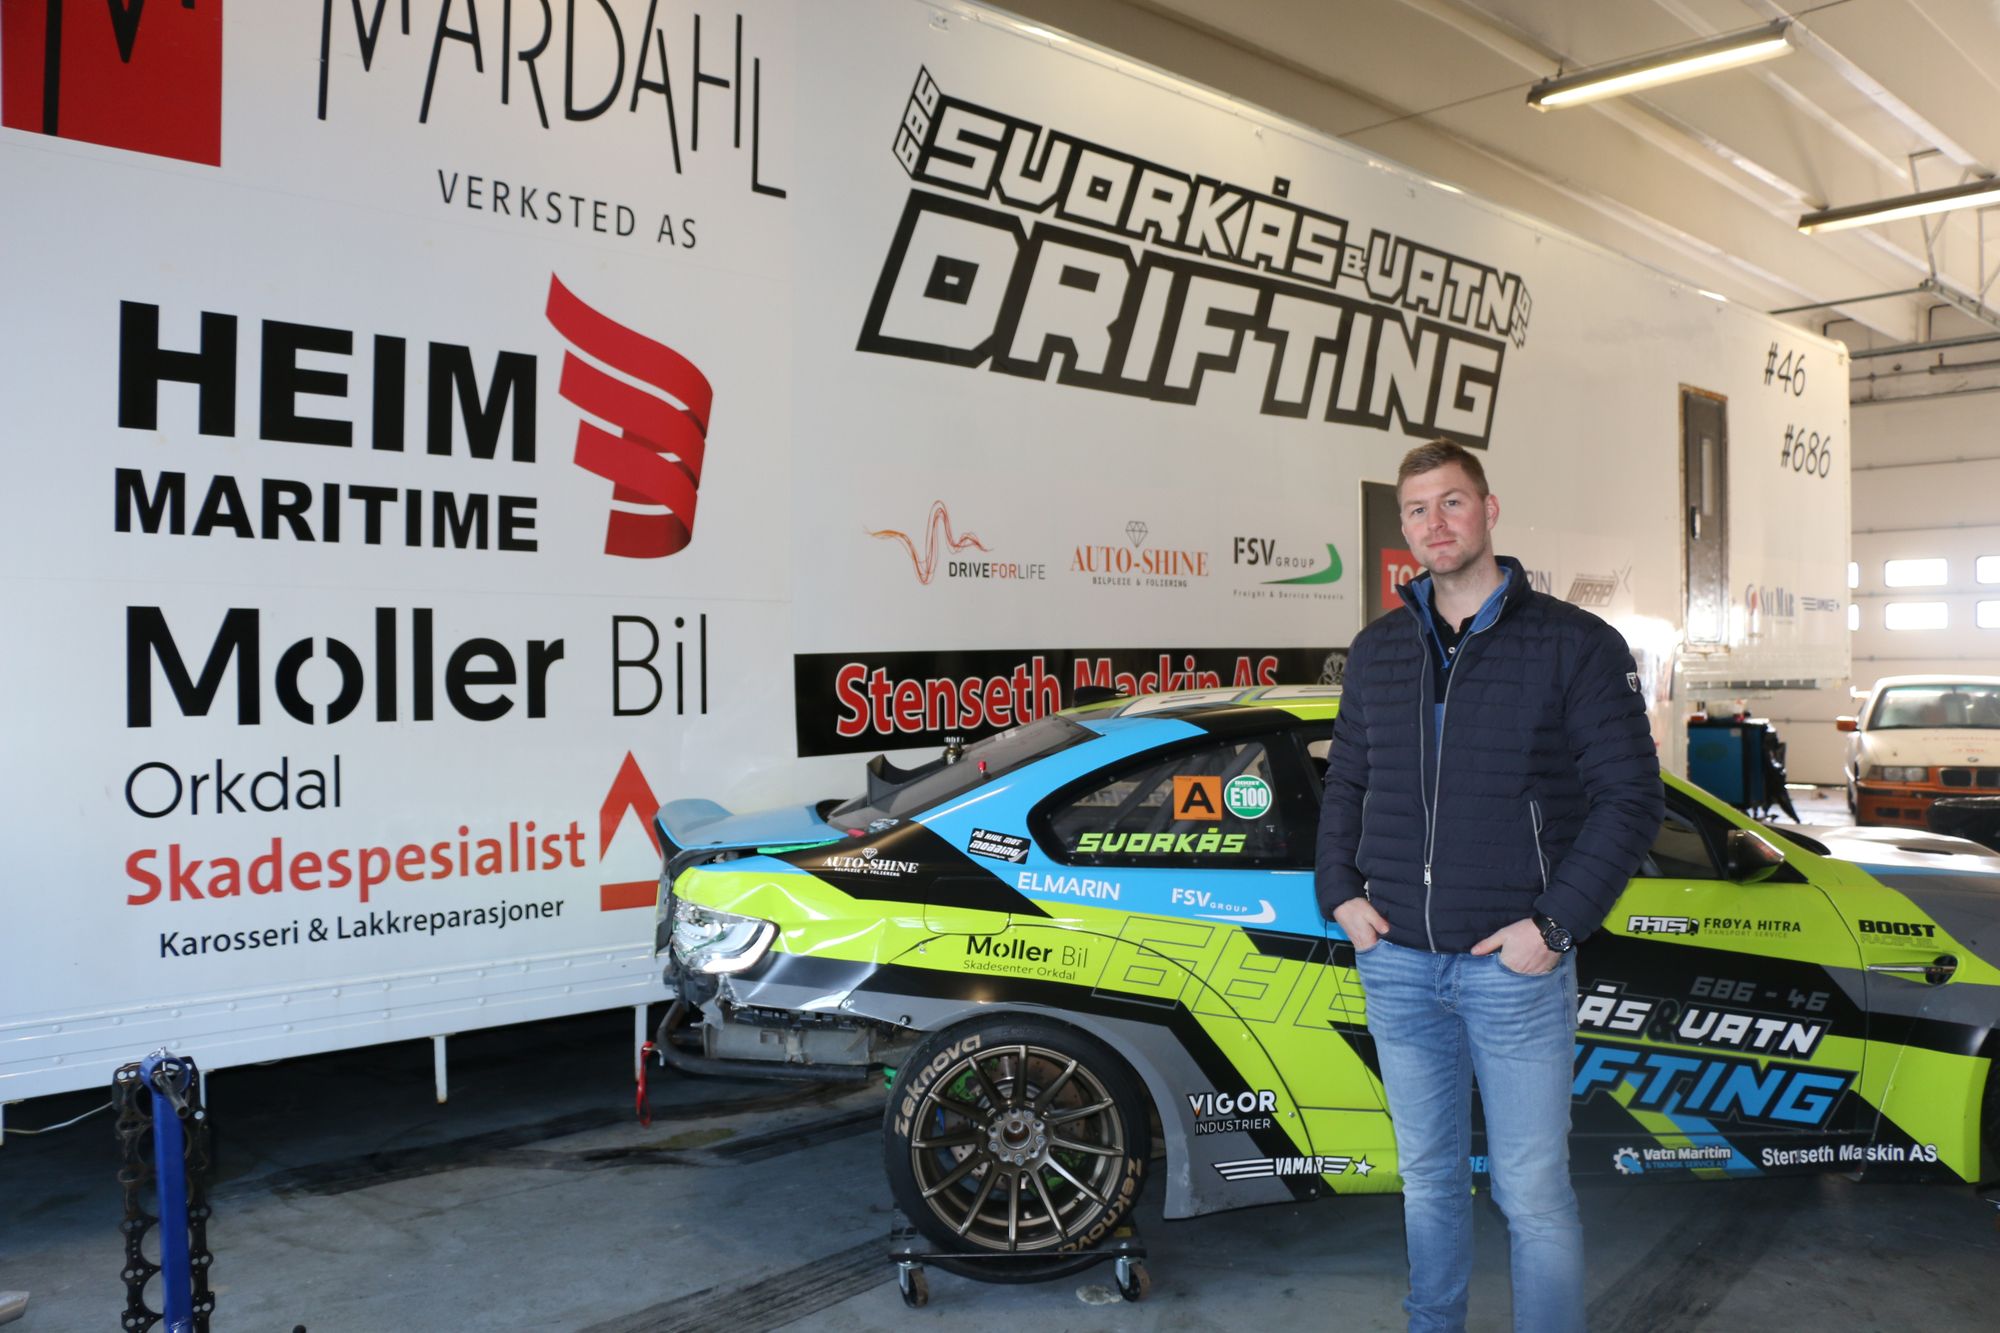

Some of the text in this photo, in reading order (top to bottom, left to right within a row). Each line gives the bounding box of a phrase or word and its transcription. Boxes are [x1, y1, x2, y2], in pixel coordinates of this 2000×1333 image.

[437, 168, 697, 250] VERKSTED AS
[856, 189, 1507, 450] DRIFTING
[118, 299, 538, 464] HEIM
[1763, 342, 1807, 397] #46
[1781, 424, 1832, 479] #686
[114, 467, 538, 553] MARITIME
[1070, 545, 1209, 577] AUTO-SHINE
[1234, 537, 1315, 568] FSV GROUP
[949, 561, 1046, 580] DRIVEFORLIFE
[1388, 564, 1428, 594] TO
[611, 613, 708, 717] Bil
[835, 656, 1061, 738] Stenseth
[125, 755, 342, 819] Orkdal
[1181, 782, 1215, 814] A
[1230, 787, 1268, 808] E100
[126, 820, 586, 905] Skadespesialist
[822, 856, 919, 874] AUTO-SHINE
[1018, 871, 1120, 901] ELMARIN
[1171, 887, 1247, 913] FSV GROUP
[160, 900, 565, 958] Karosseri & Lakkreparasjoner
[1704, 918, 1801, 932] FRØYA HITRA
[1858, 920, 1936, 938] BOOST
[963, 960, 1076, 980] Skadesenter Orkdal
[1061, 946, 1088, 968] Bil
[1690, 976, 1756, 1001] 686
[1572, 1043, 1846, 1124] FTING
[1188, 1088, 1277, 1118] VIGOR
[1195, 1118, 1271, 1135] INDUSTRIER
[1275, 1157, 1324, 1176] VAMAR
[1643, 1146, 1731, 1160] Vatn Maritim
[1762, 1144, 1938, 1167] Stenseth Maskin AS
